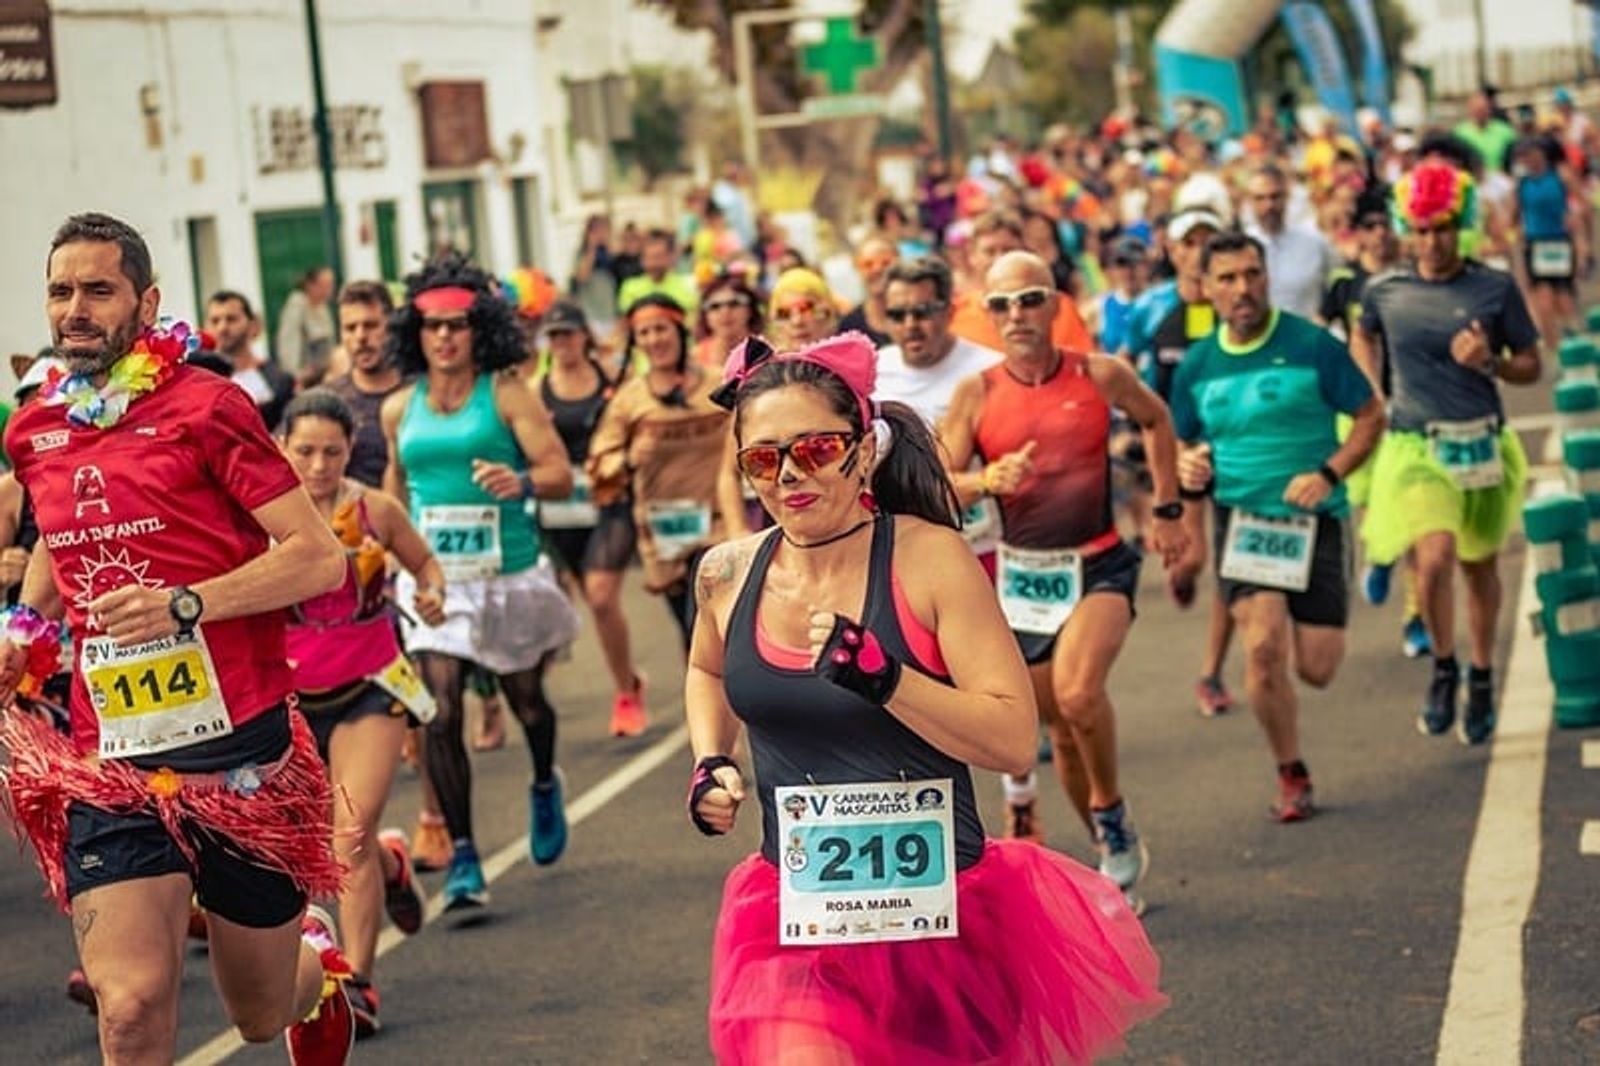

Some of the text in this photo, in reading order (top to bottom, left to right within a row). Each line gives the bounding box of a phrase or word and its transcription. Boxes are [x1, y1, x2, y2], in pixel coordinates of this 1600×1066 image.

[437, 530, 485, 553] 271
[100, 643, 109, 659] V
[114, 661, 197, 708] 114
[810, 791, 909, 817] V CARRERA DE
[833, 803, 911, 816] MASCARITAS
[818, 833, 930, 881] 219
[826, 898, 912, 912] ROSA MARIA
